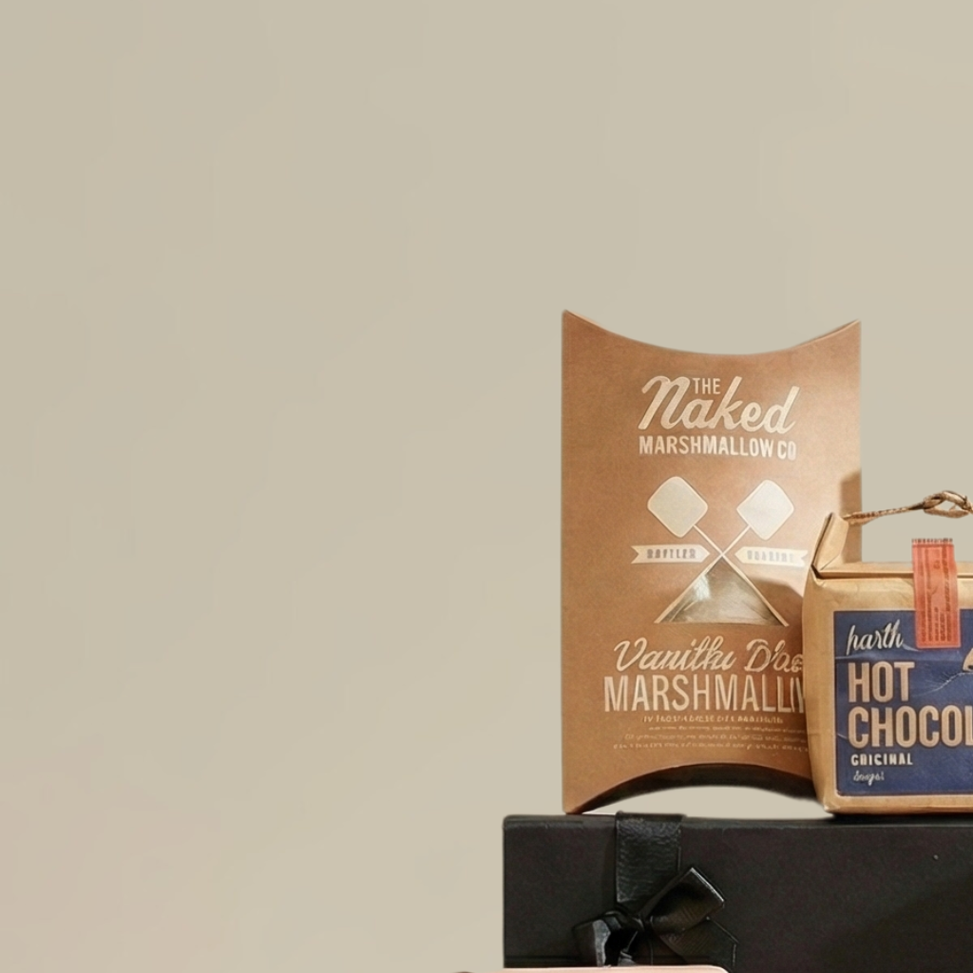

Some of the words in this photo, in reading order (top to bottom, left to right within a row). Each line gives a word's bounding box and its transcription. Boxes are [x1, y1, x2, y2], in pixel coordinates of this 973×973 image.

[693, 377, 721, 394] THE
[638, 375, 800, 434] Naked
[638, 435, 774, 458] MARSHMALLOW
[848, 661, 915, 703] HOT
